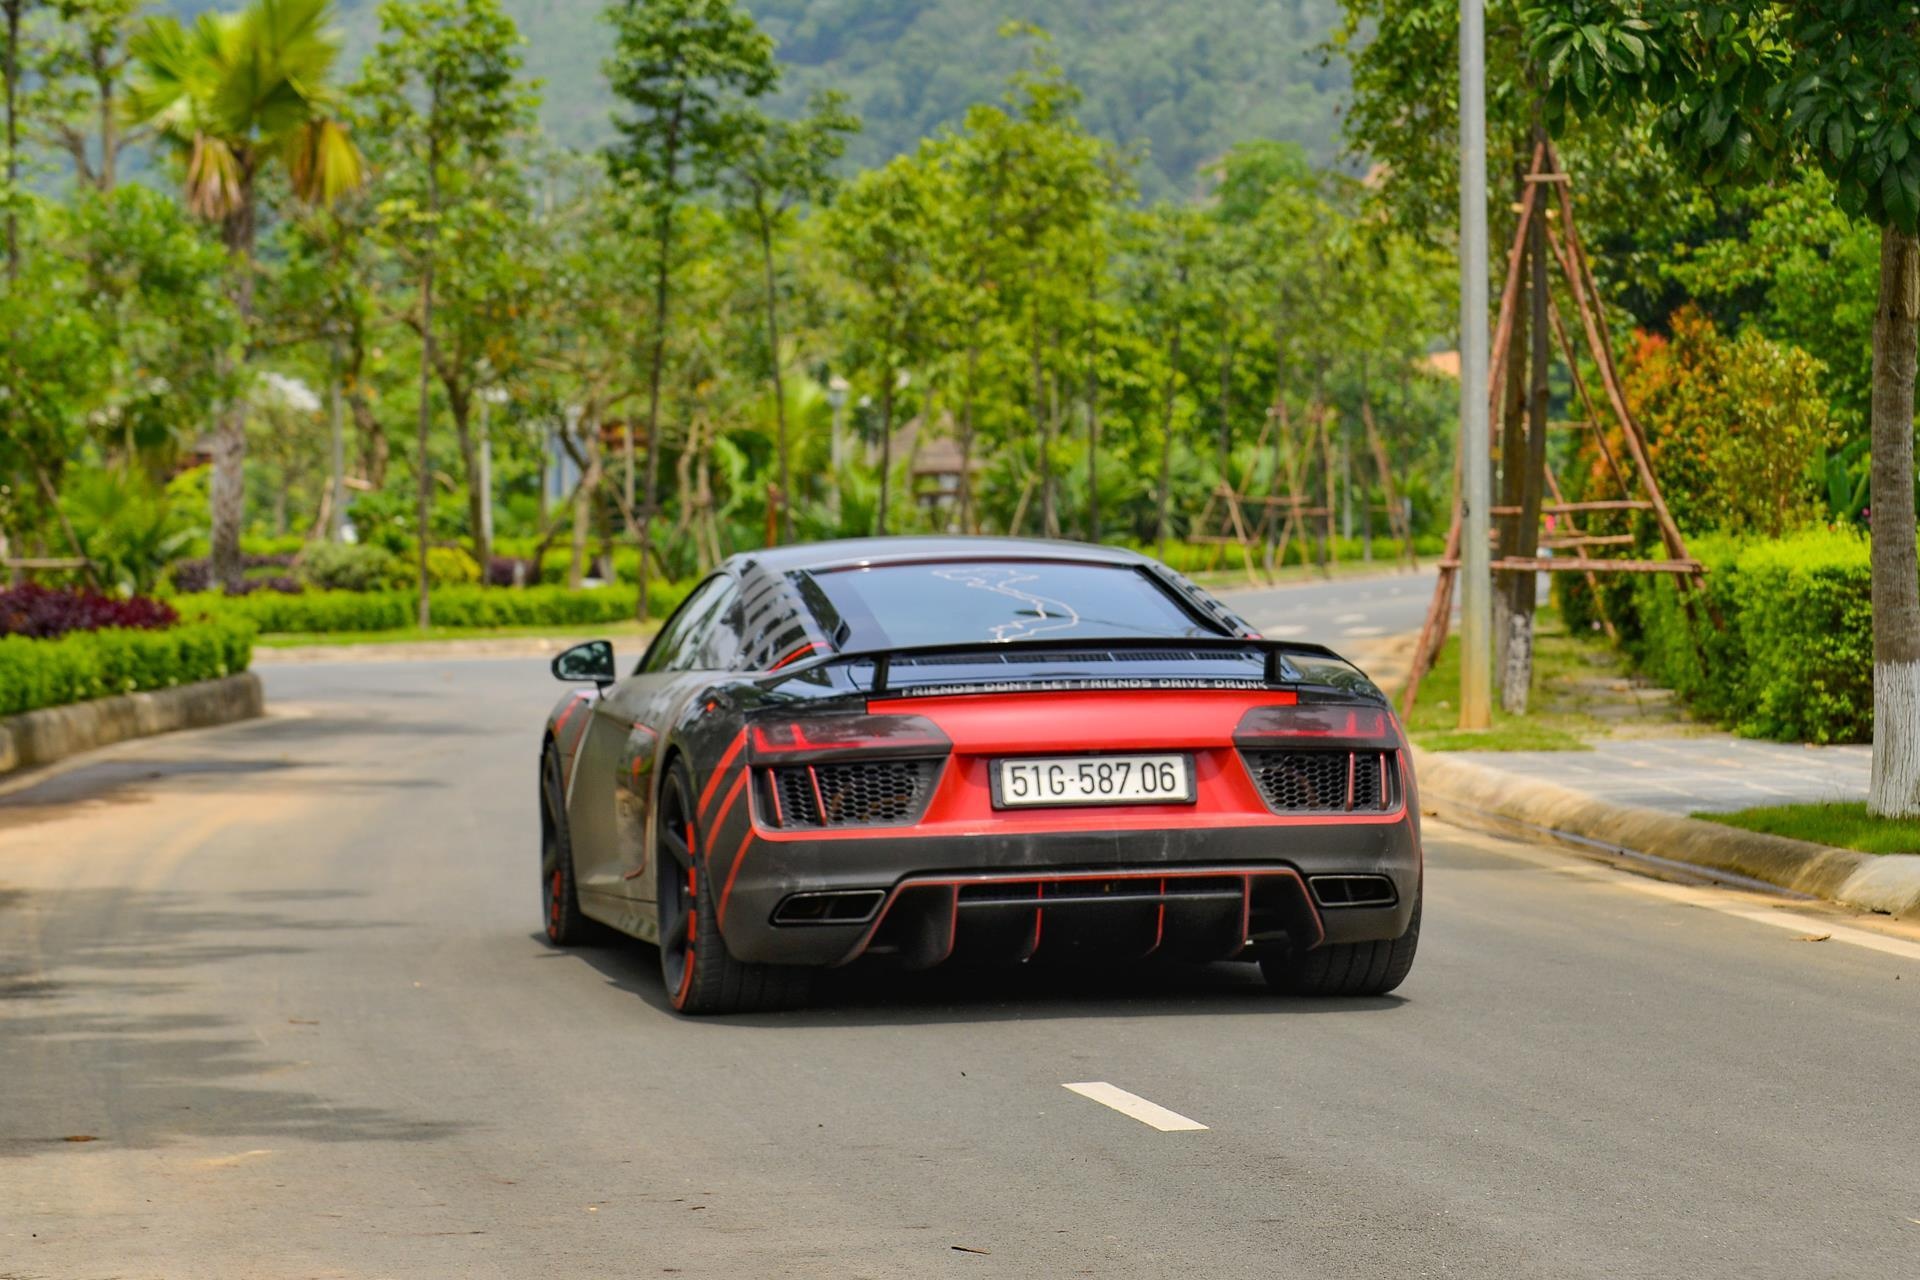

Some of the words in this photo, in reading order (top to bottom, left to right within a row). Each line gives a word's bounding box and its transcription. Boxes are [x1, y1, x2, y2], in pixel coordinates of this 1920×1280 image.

[1079, 678, 1152, 689] FRIENDS
[1159, 678, 1208, 689] DRIVE
[1214, 678, 1269, 690] DRUNK
[1009, 761, 1176, 797] 51G-587.06
